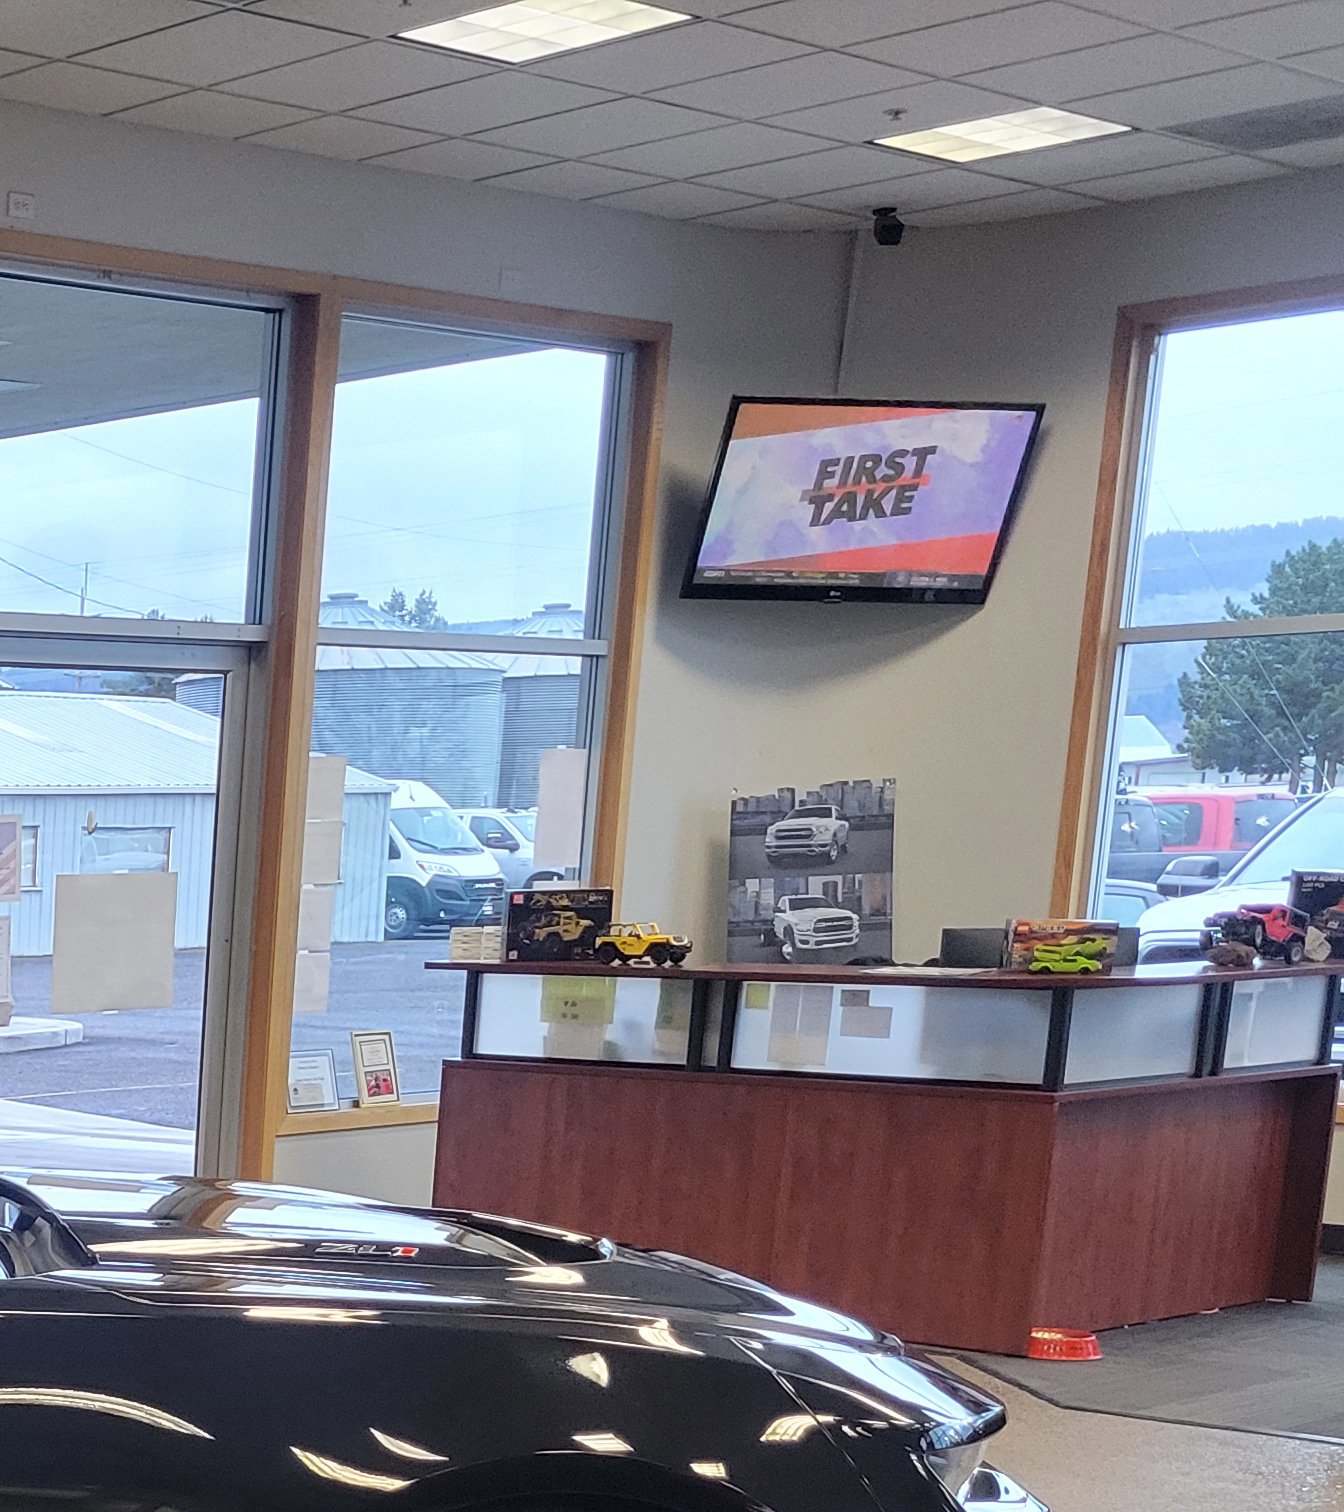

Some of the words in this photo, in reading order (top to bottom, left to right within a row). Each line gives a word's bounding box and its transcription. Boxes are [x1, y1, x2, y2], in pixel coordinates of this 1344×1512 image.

[814, 445, 938, 491] FIRST
[808, 483, 920, 527] TAKE
[315, 1242, 420, 1258] ZL1
